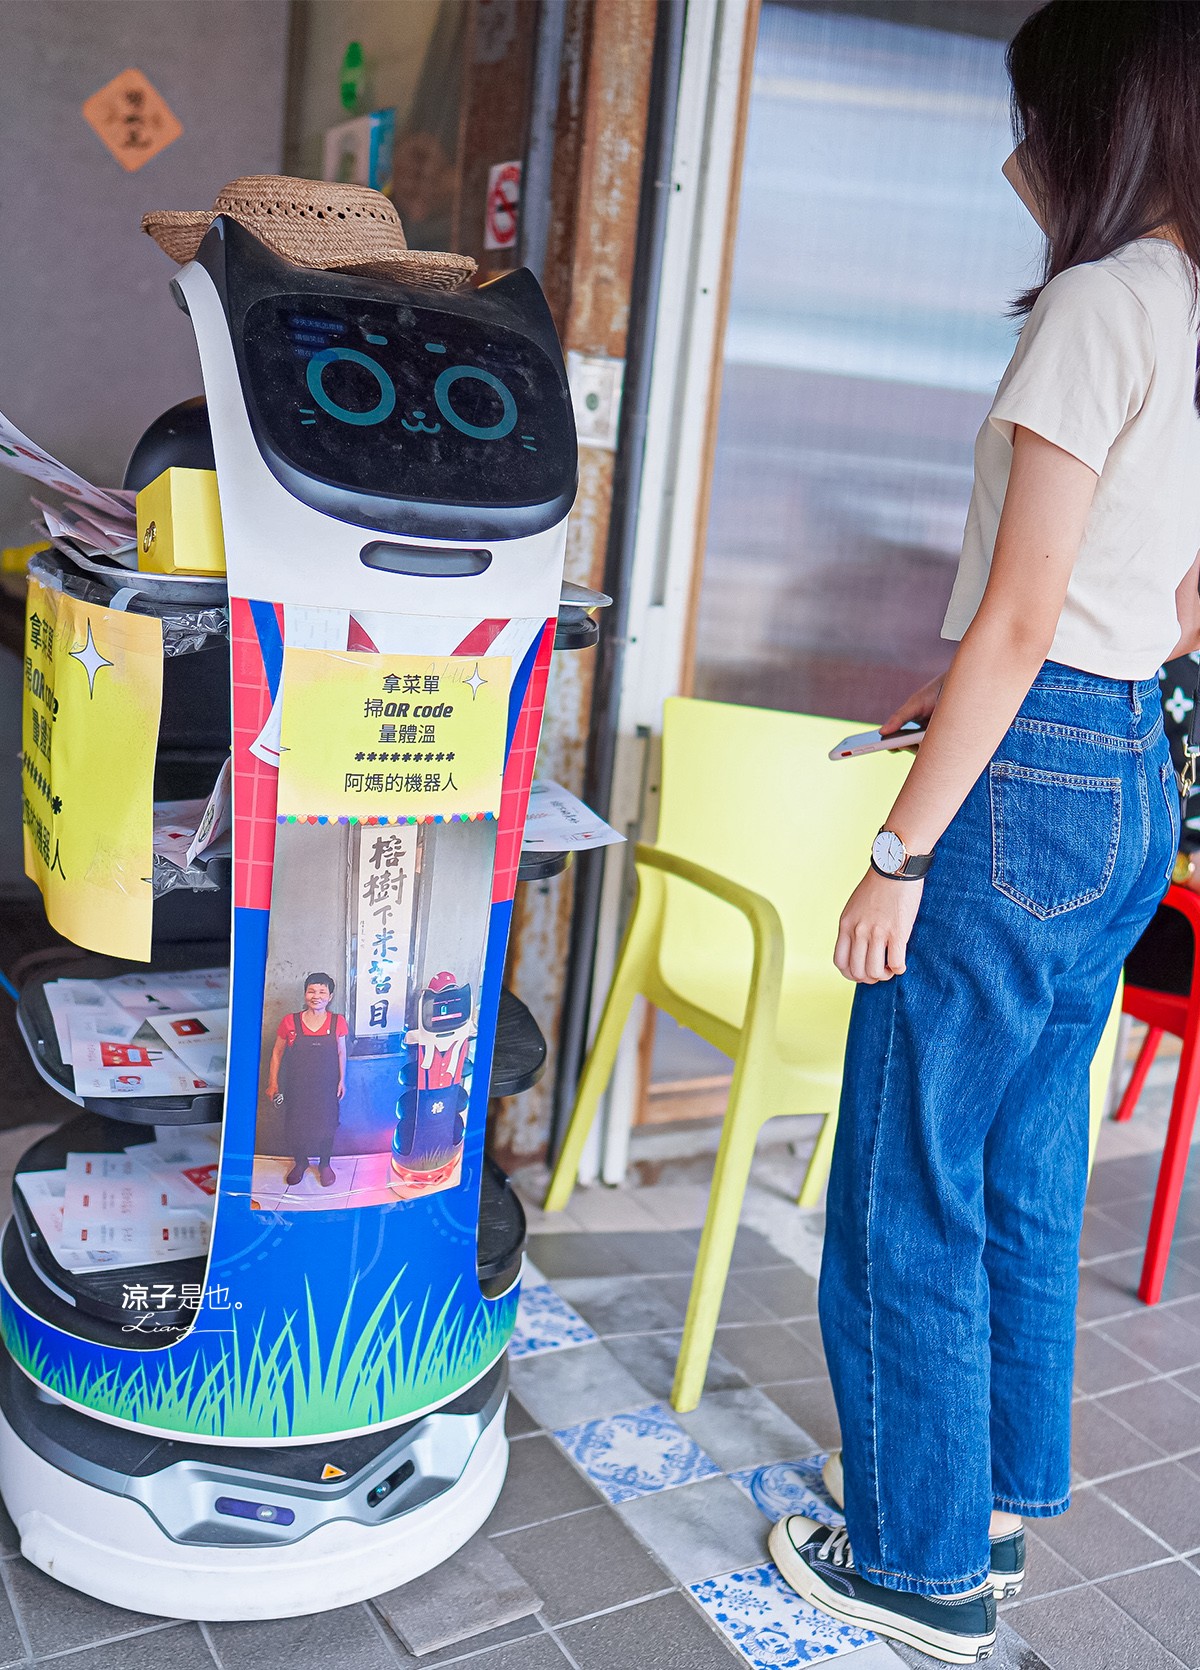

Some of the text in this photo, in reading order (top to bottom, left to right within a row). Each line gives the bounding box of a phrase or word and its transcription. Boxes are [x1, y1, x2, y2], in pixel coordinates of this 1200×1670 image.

[382, 673, 440, 694] 拿菜單
[364, 698, 454, 718] 掃QR code
[378, 724, 436, 744] 量體溫
[344, 772, 458, 793] 阿媽的機器人
[363, 834, 407, 1029] 榕樹下米苔目
